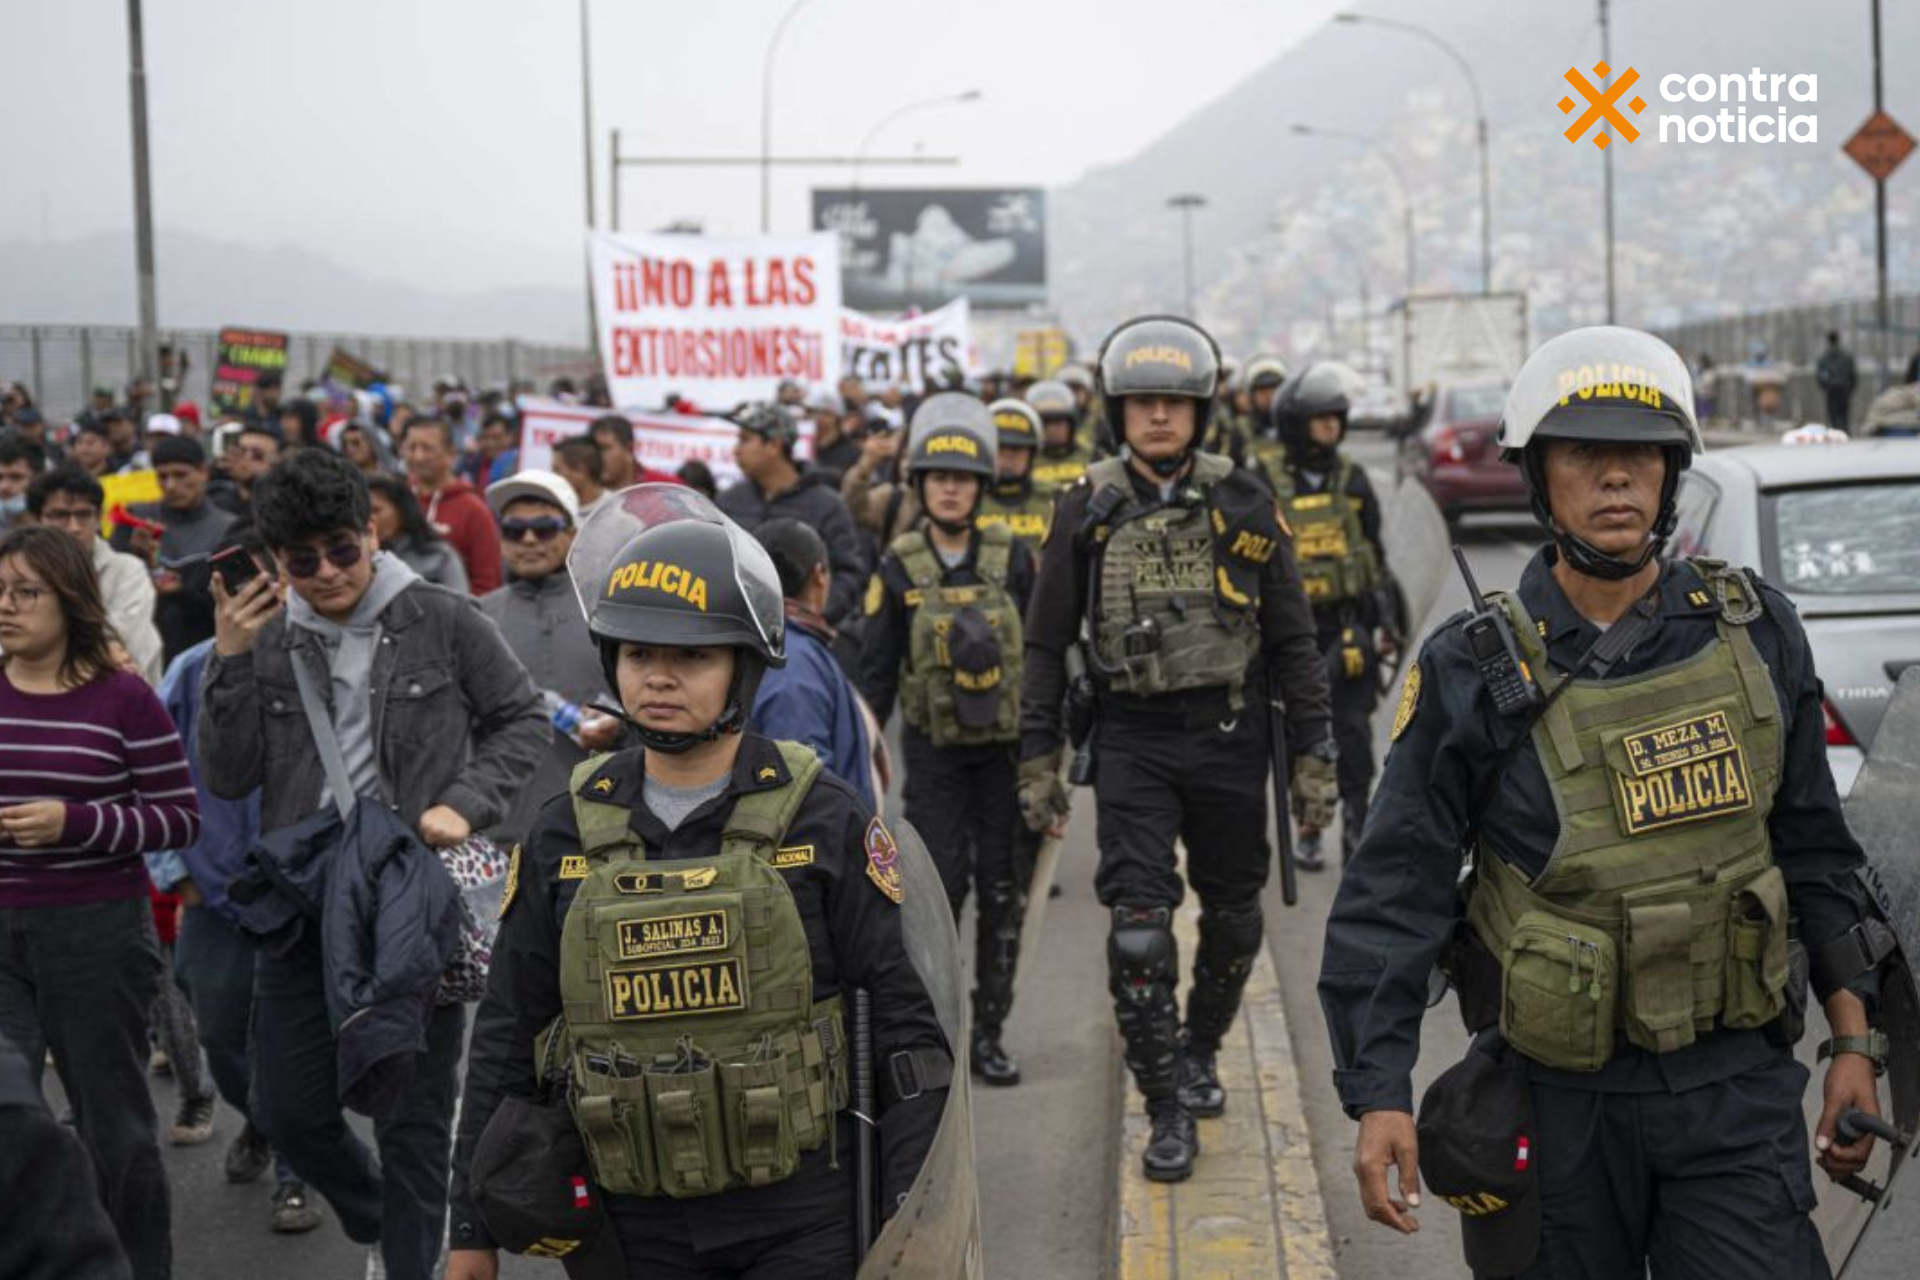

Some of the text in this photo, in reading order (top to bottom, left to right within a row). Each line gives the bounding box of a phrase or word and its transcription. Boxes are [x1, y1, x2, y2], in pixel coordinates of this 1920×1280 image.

[708, 260, 732, 306] A
[745, 257, 816, 306] LAS
[1125, 346, 1193, 372] POLICIA
[1558, 364, 1661, 409] POLICIA
[927, 436, 977, 456] POLICIA
[608, 561, 707, 611] POLICIA
[1652, 723, 1701, 749] MEZA
[1625, 756, 1745, 821] POLICIA
[643, 918, 701, 941] SALINAS
[612, 966, 739, 1014] POLICIA
